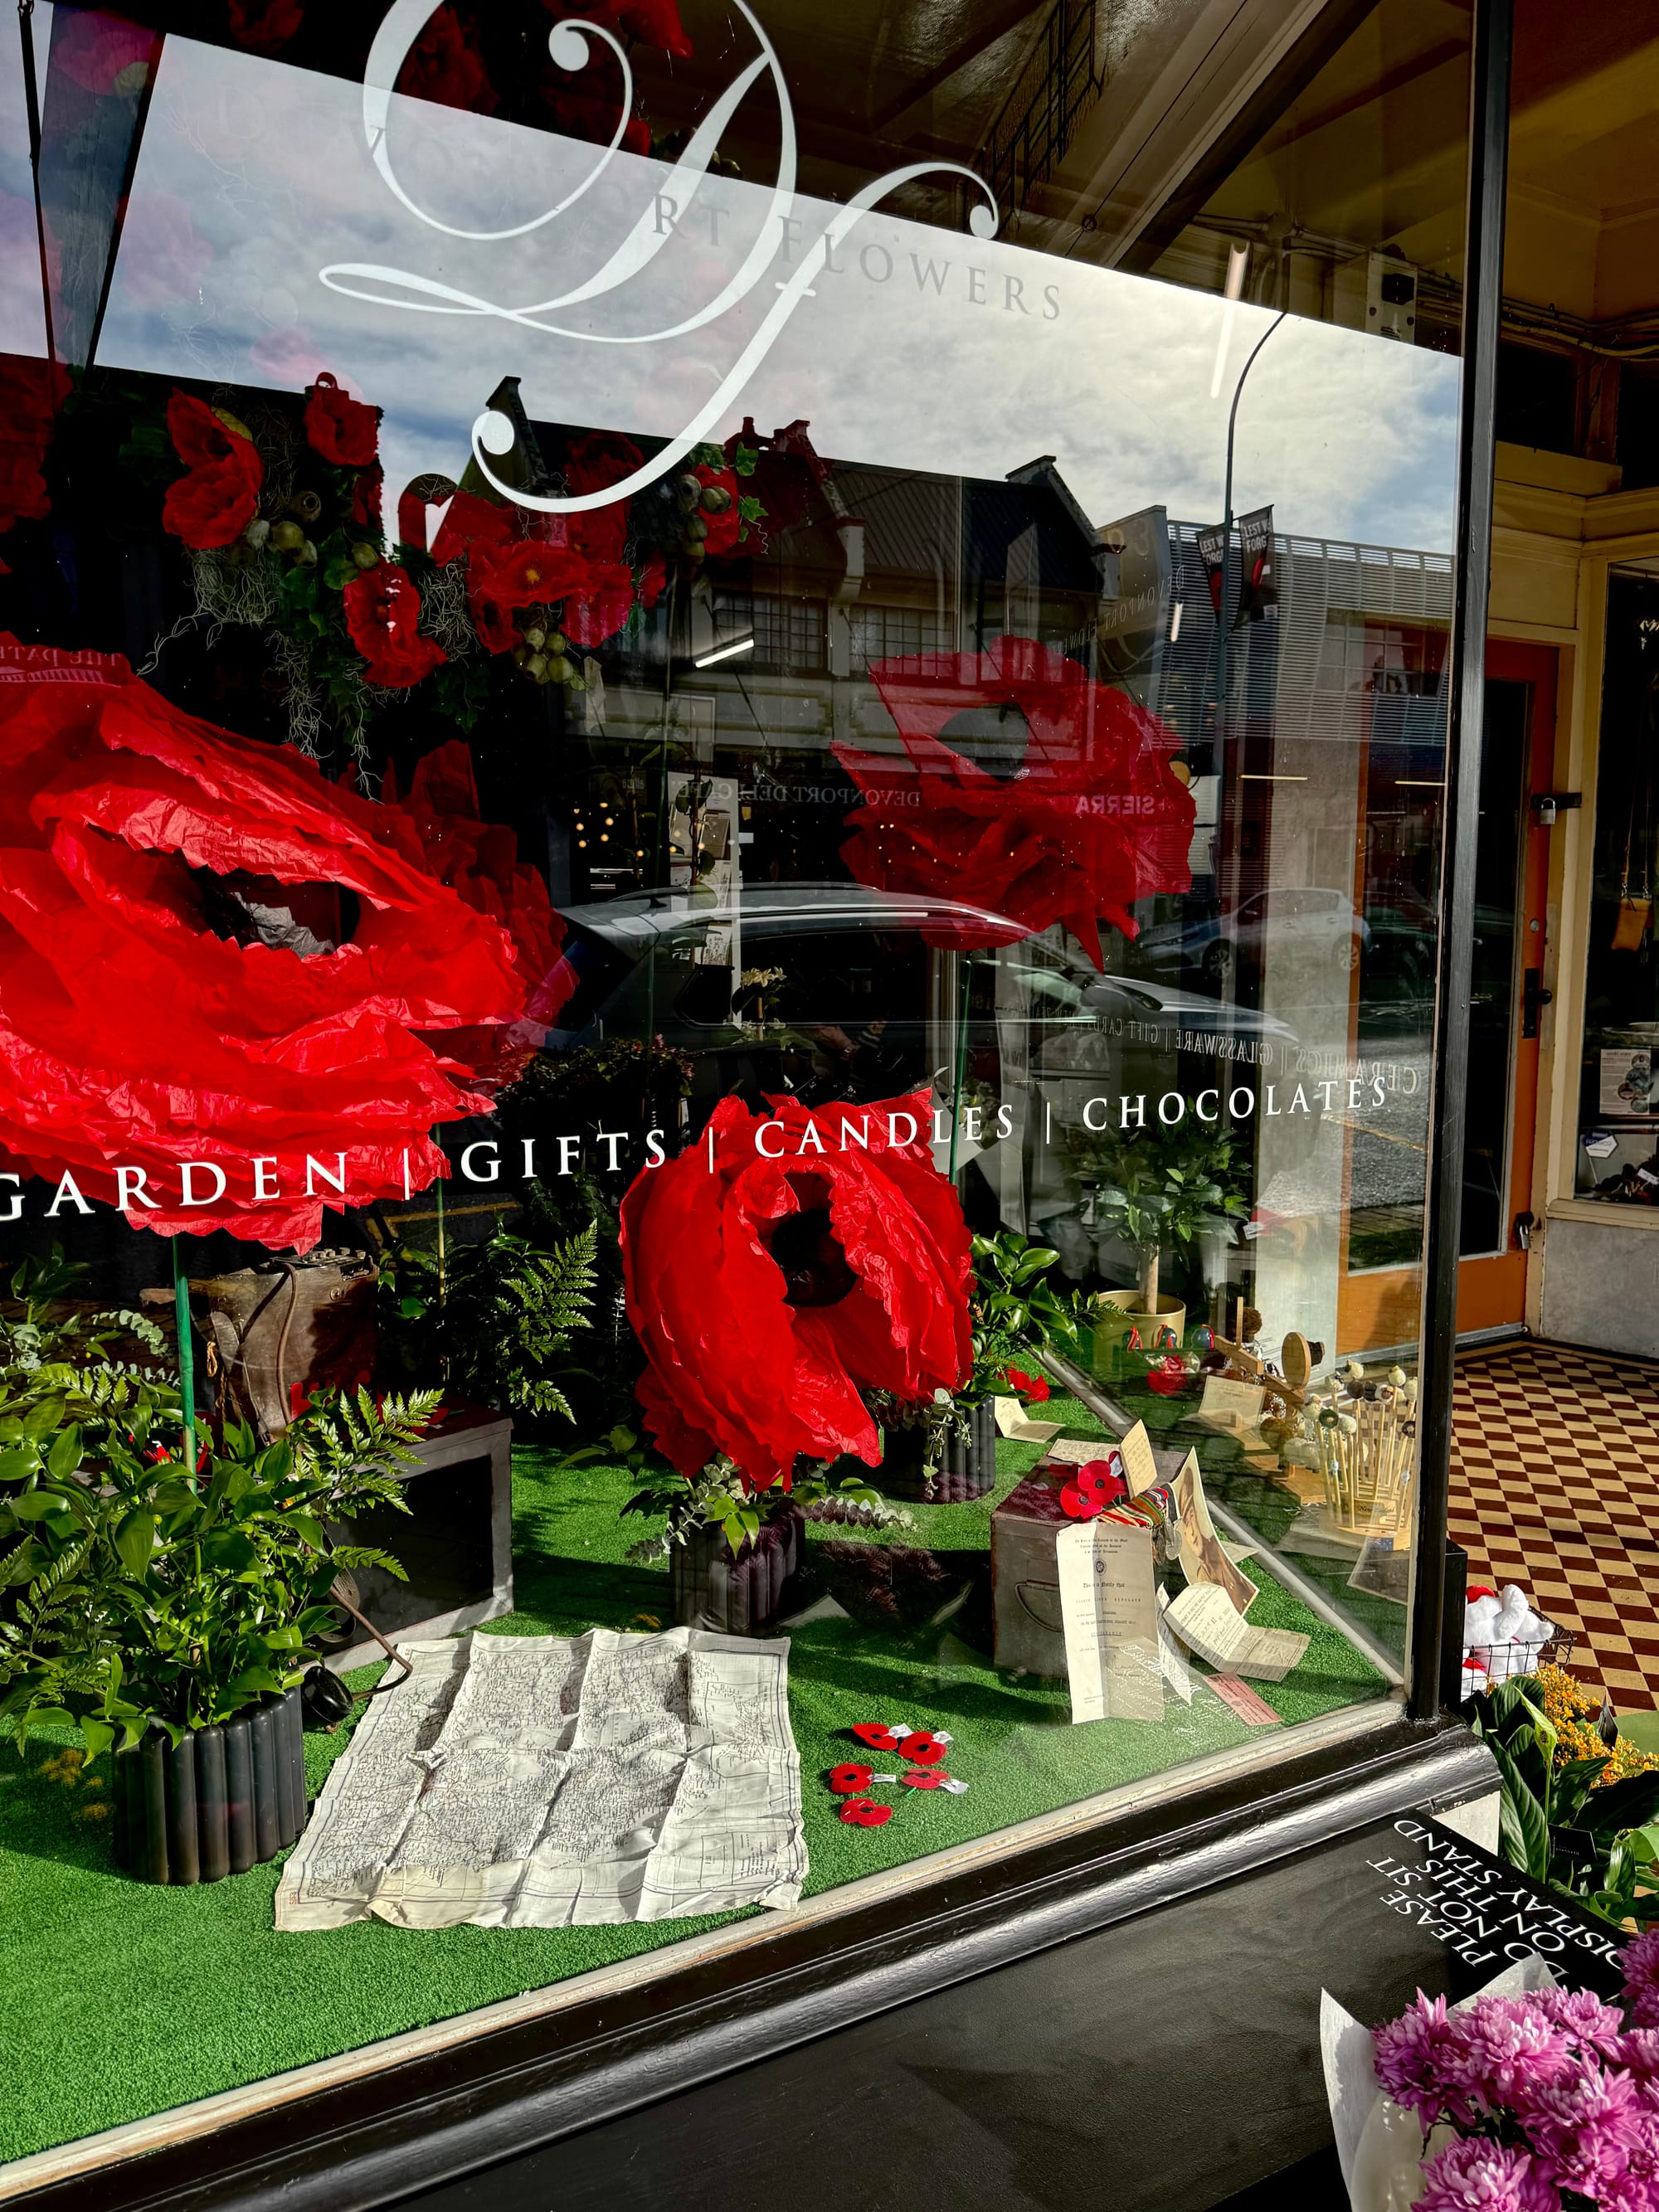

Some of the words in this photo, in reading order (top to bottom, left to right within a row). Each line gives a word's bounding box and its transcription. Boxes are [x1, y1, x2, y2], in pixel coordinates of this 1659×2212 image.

[776, 214, 1060, 321] FLOWERS
[1244, 521, 1261, 538] LEST
[0, 1151, 348, 1223] GARDEN
[460, 1129, 666, 1183] GIFTS
[754, 1102, 1014, 1160] CANDLES
[1082, 1075, 1387, 1131] CHOCOLATES
[1365, 1856, 1423, 1887] SIT
[1394, 1820, 1503, 1885] STAND
[1415, 1859, 1498, 1912] THIS
[1379, 1889, 1498, 1967] PLEASE
[1416, 1889, 1503, 1938] NOT
[1499, 1912, 1565, 1952] ON
